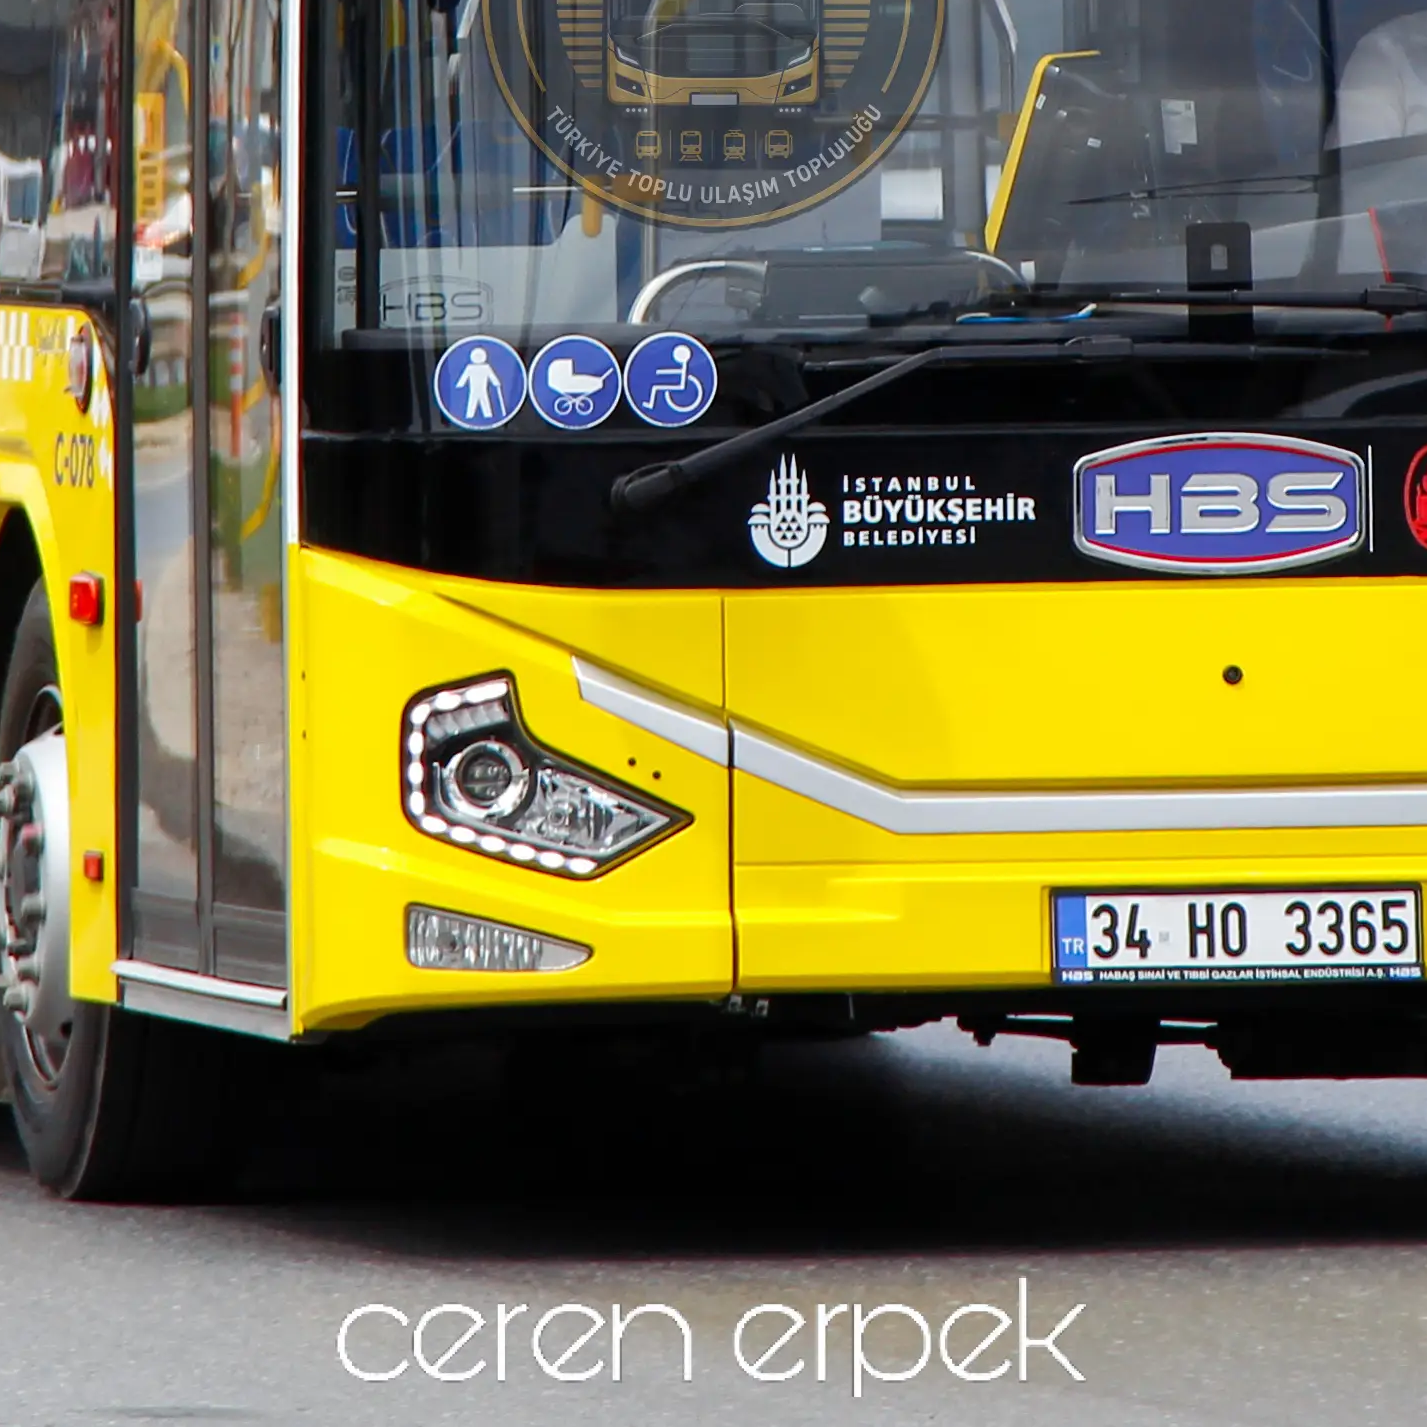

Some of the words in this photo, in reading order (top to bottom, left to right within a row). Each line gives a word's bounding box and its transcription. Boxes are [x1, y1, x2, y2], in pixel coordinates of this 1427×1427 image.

[55, 431, 95, 488] C-078
[842, 475, 976, 493] İSTANBUL
[842, 493, 1037, 525] BÜYÜKŞEHİR
[1093, 472, 1350, 536] HBS
[842, 526, 977, 548] BELEDİYESİ
[1061, 937, 1085, 956] TR
[1091, 902, 1152, 960] 34
[1187, 902, 1248, 959] HO
[1284, 899, 1410, 957] 3365
[1167, 969, 1182, 981] VE
[1211, 968, 1253, 981] GAZLAR
